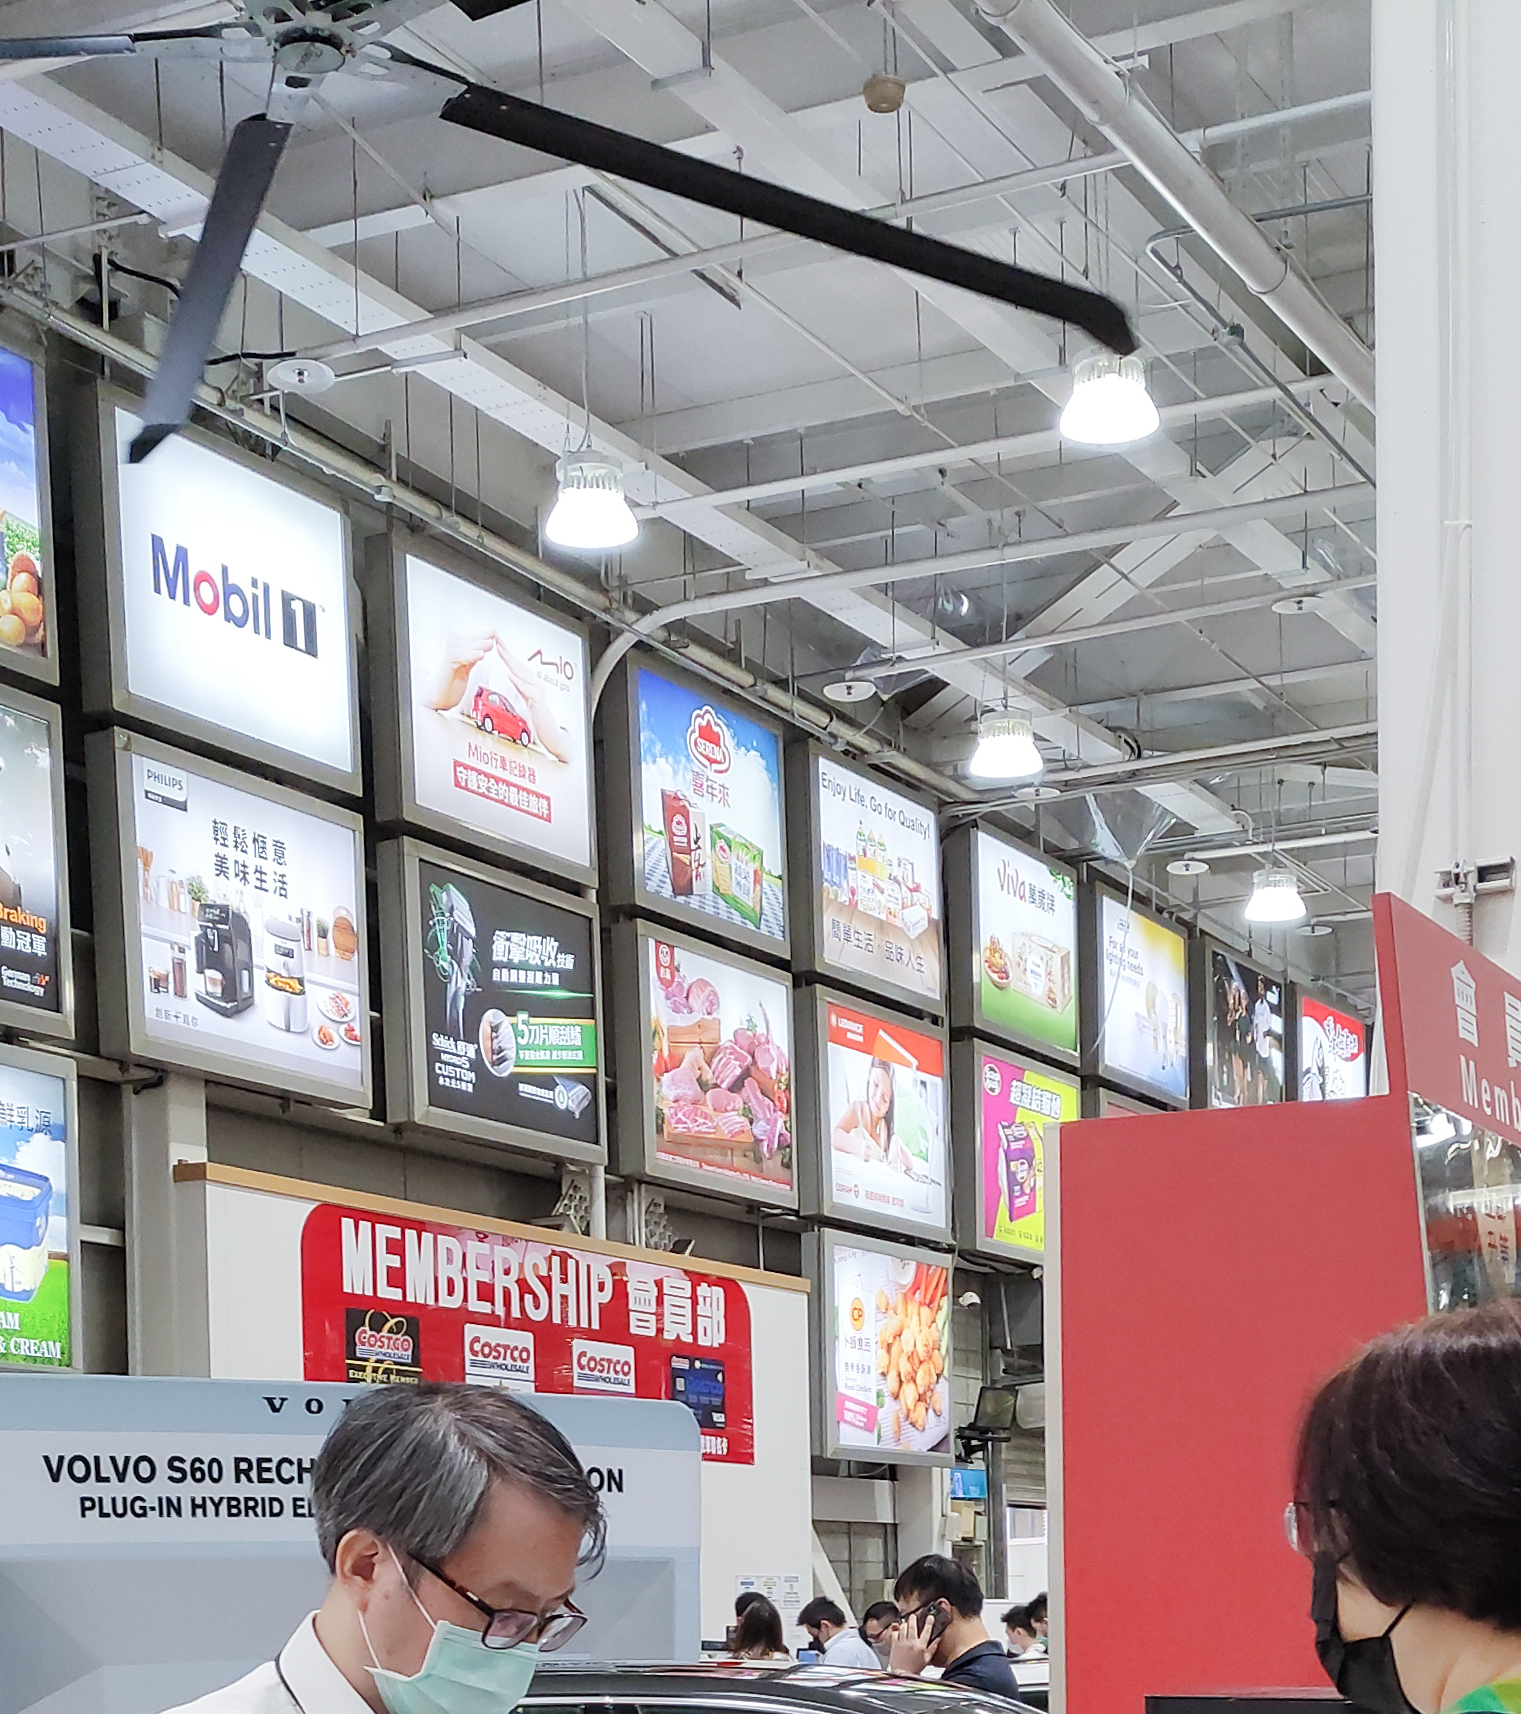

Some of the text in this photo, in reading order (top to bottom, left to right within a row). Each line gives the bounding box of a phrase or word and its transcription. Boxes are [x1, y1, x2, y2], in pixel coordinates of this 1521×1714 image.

[151, 531, 272, 641] Mobil
[146, 768, 184, 791] PHILIPS
[821, 771, 931, 842] Enjoy Life. Go for Quality!
[212, 817, 288, 868] 輕鬆愜意
[214, 851, 289, 900] 美味生活
[435, 1062, 476, 1083] CUSTOM
[340, 1216, 727, 1348] MEMBERSHIP 會員部
[9, 1336, 63, 1360] CREAM
[357, 1328, 412, 1352] COSTCO
[469, 1335, 531, 1364] COSTCO
[489, 1361, 530, 1375] WHOLESALE
[576, 1350, 632, 1378] COSTCO
[42, 1453, 316, 1486] VOLVO S60 RECH
[78, 1496, 183, 1520] PLUG-IN
[190, 1496, 284, 1520] HYBRID
